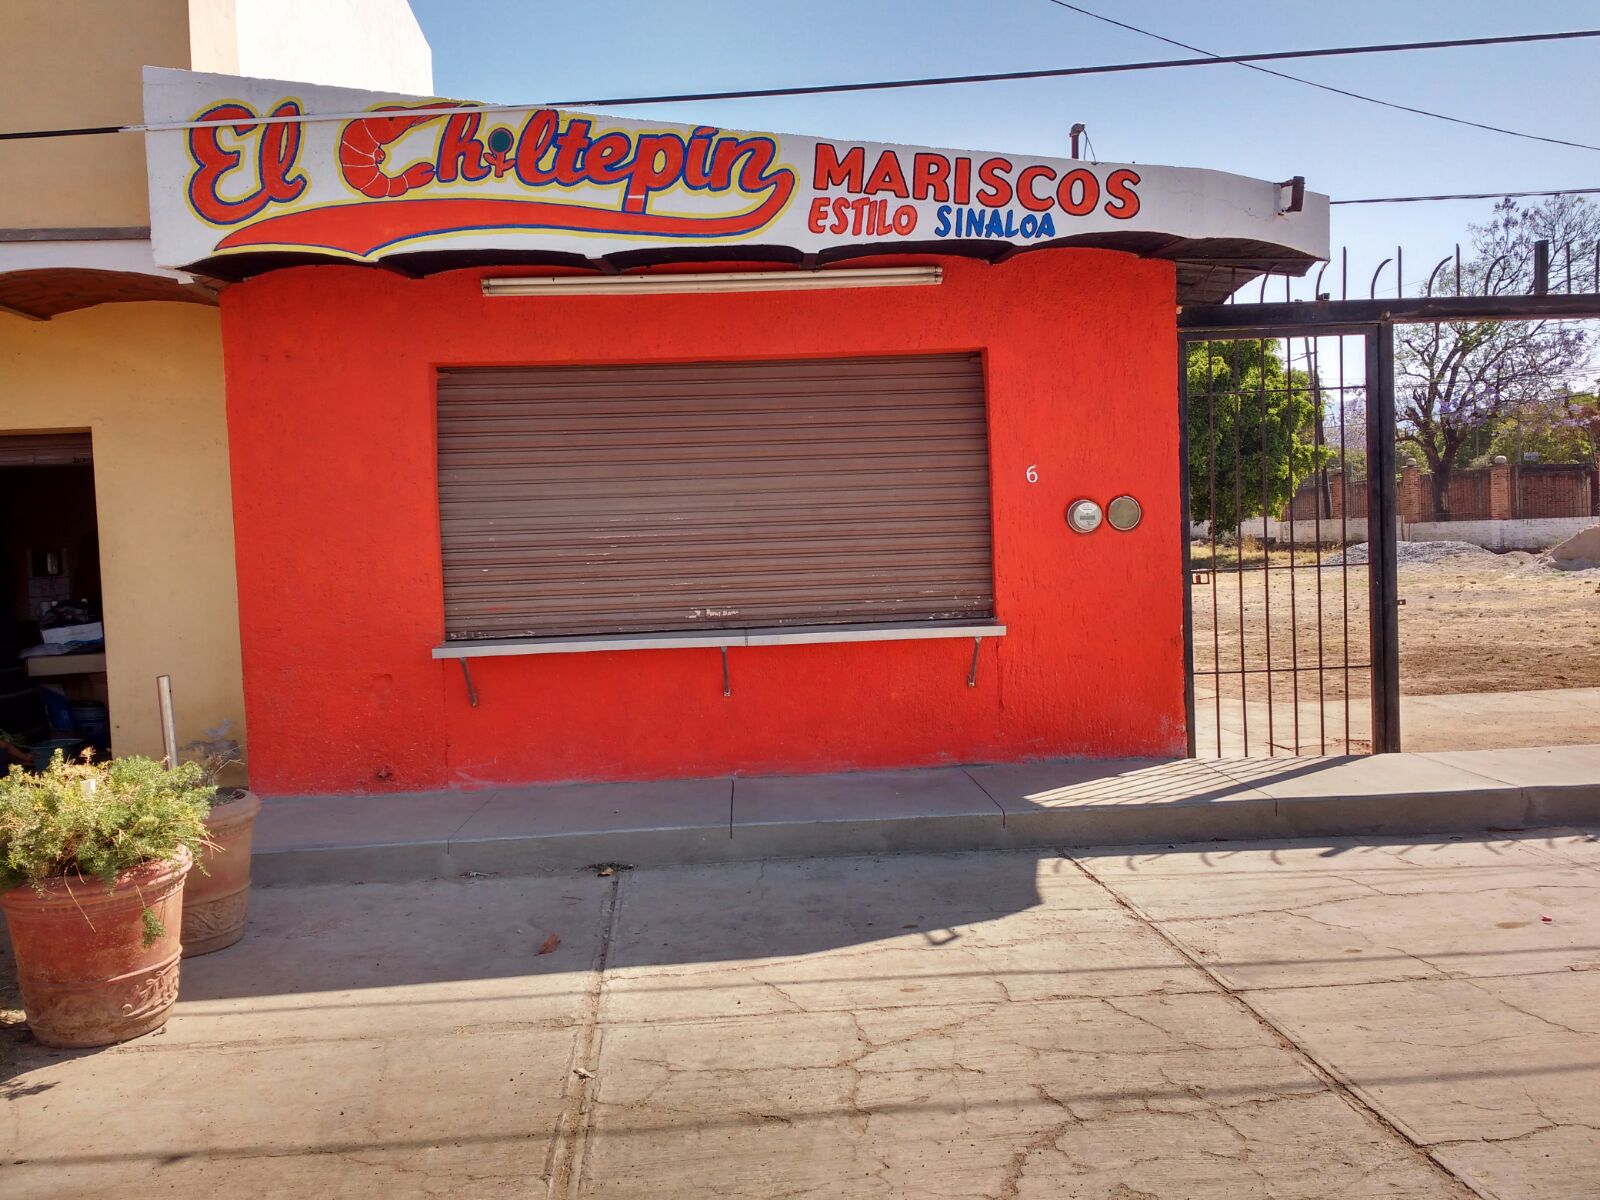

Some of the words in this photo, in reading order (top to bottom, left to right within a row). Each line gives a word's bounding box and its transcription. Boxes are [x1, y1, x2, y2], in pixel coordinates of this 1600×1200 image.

[188, 101, 308, 225] El
[813, 143, 1141, 219] MARISCOS
[808, 197, 918, 236] ESTILO
[934, 205, 1056, 238] SINALOA
[1026, 465, 1038, 483] 6
